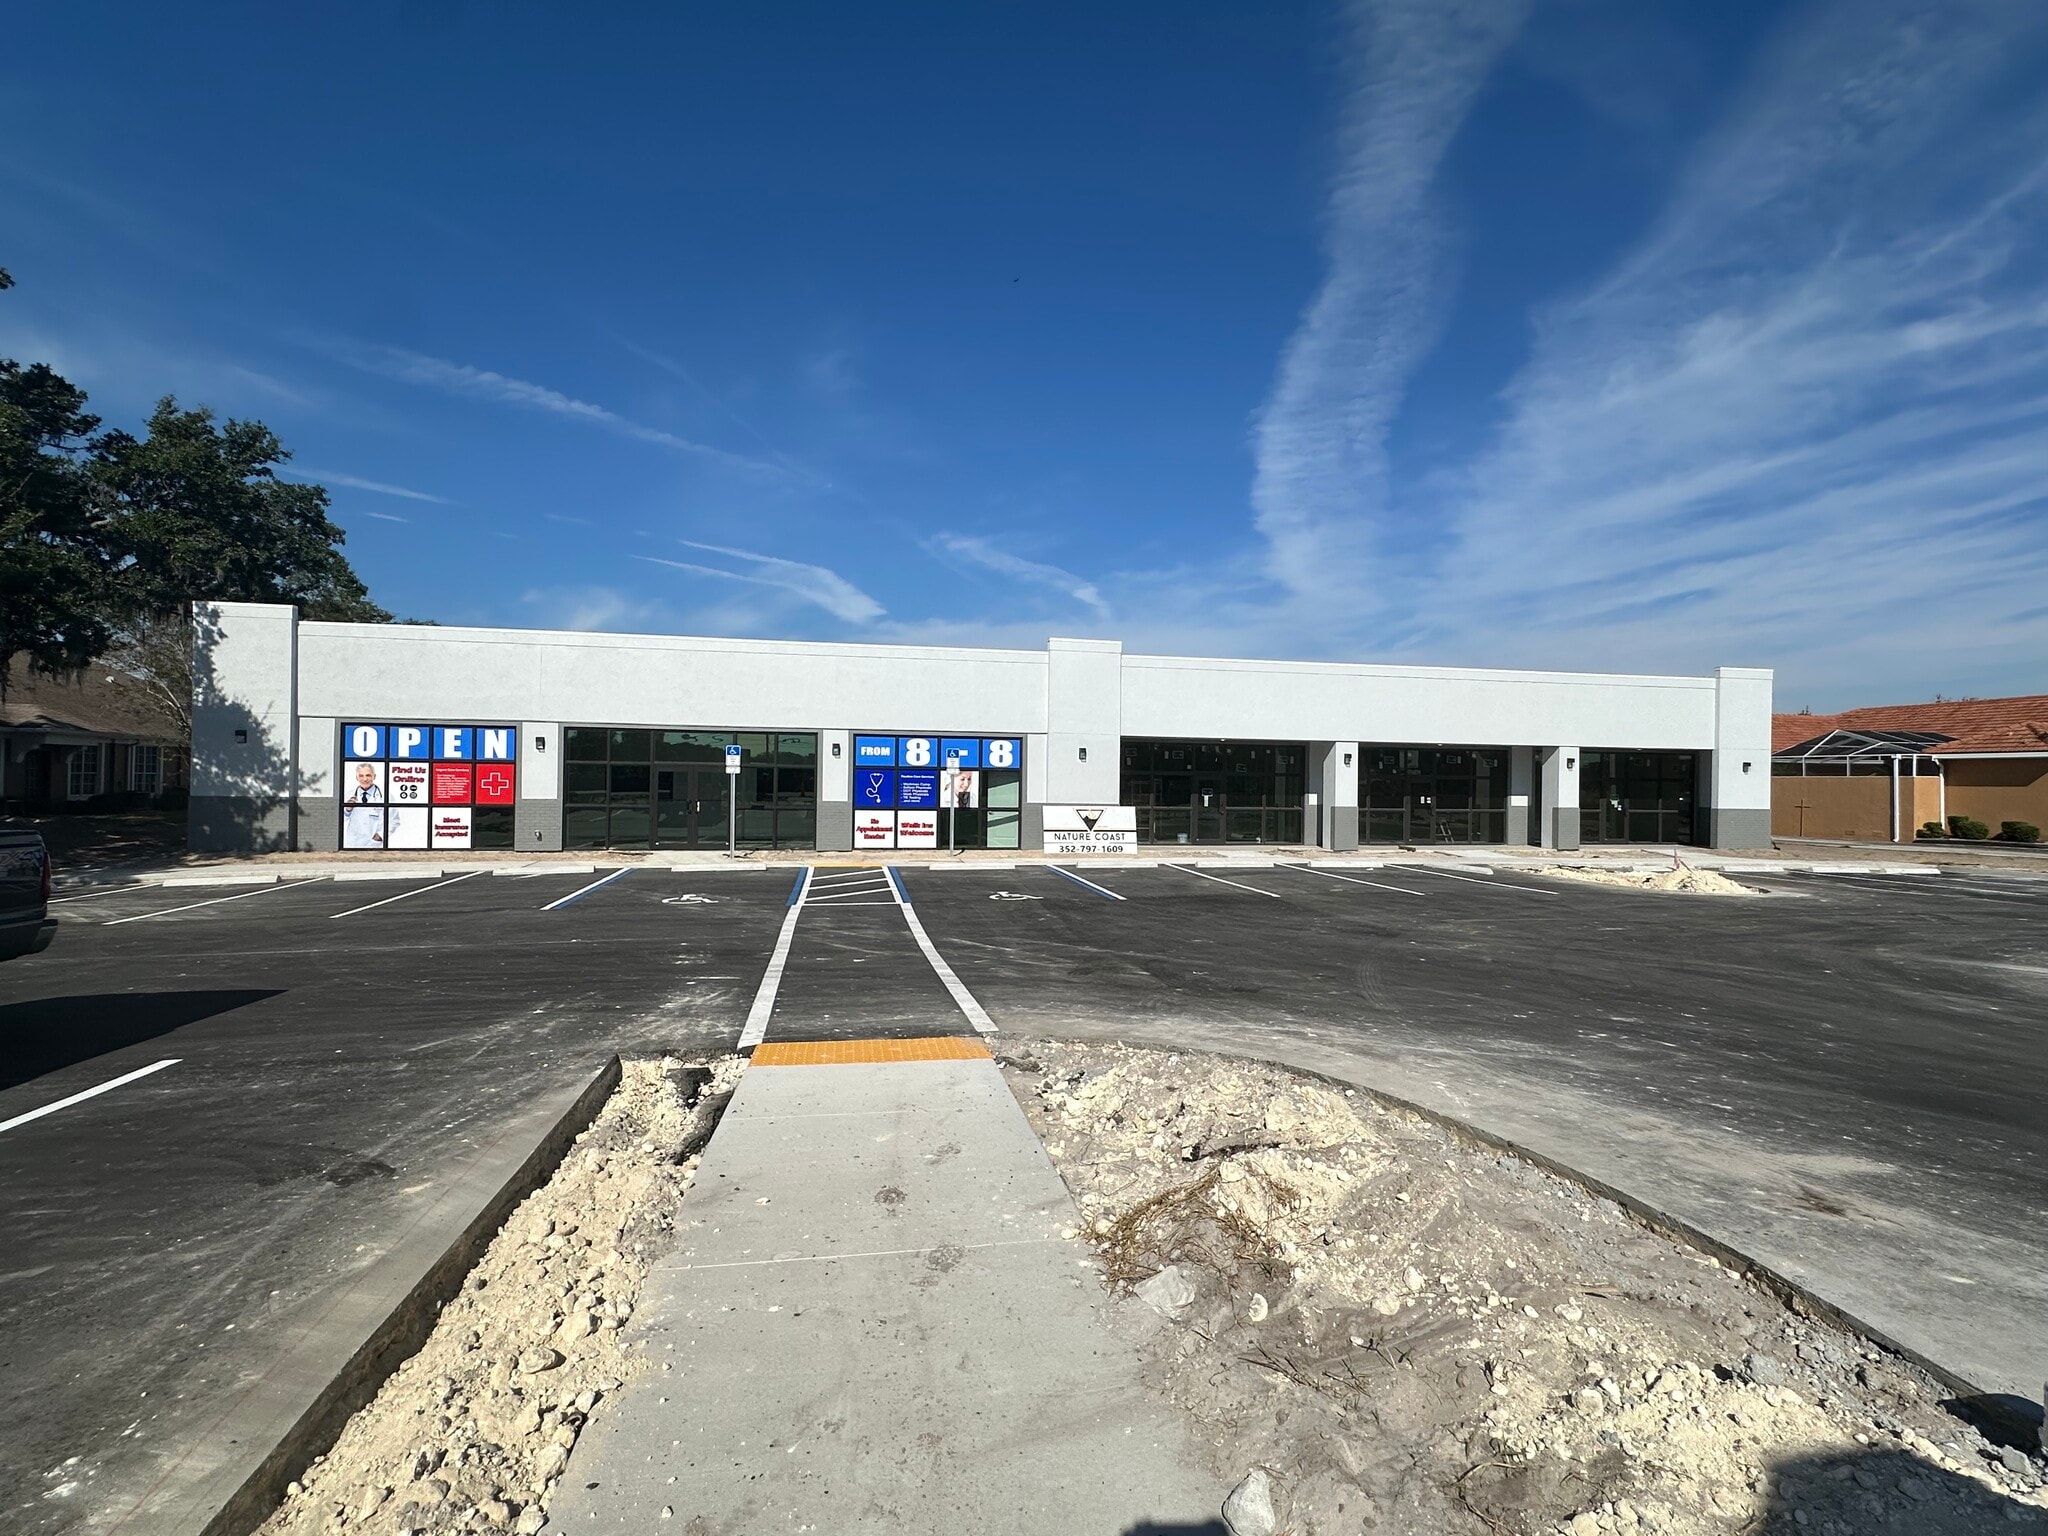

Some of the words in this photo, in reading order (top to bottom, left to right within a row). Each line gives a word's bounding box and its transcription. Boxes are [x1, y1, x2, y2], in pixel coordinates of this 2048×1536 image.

[353, 726, 508, 759] OPEN
[861, 746, 891, 756] FROM
[905, 738, 931, 766] 8
[989, 740, 1014, 767] 8
[391, 766, 413, 774] Find
[1054, 832, 1091, 841] NATURE
[1094, 832, 1126, 841] COAST
[1059, 845, 1124, 853] 352-797-1609
